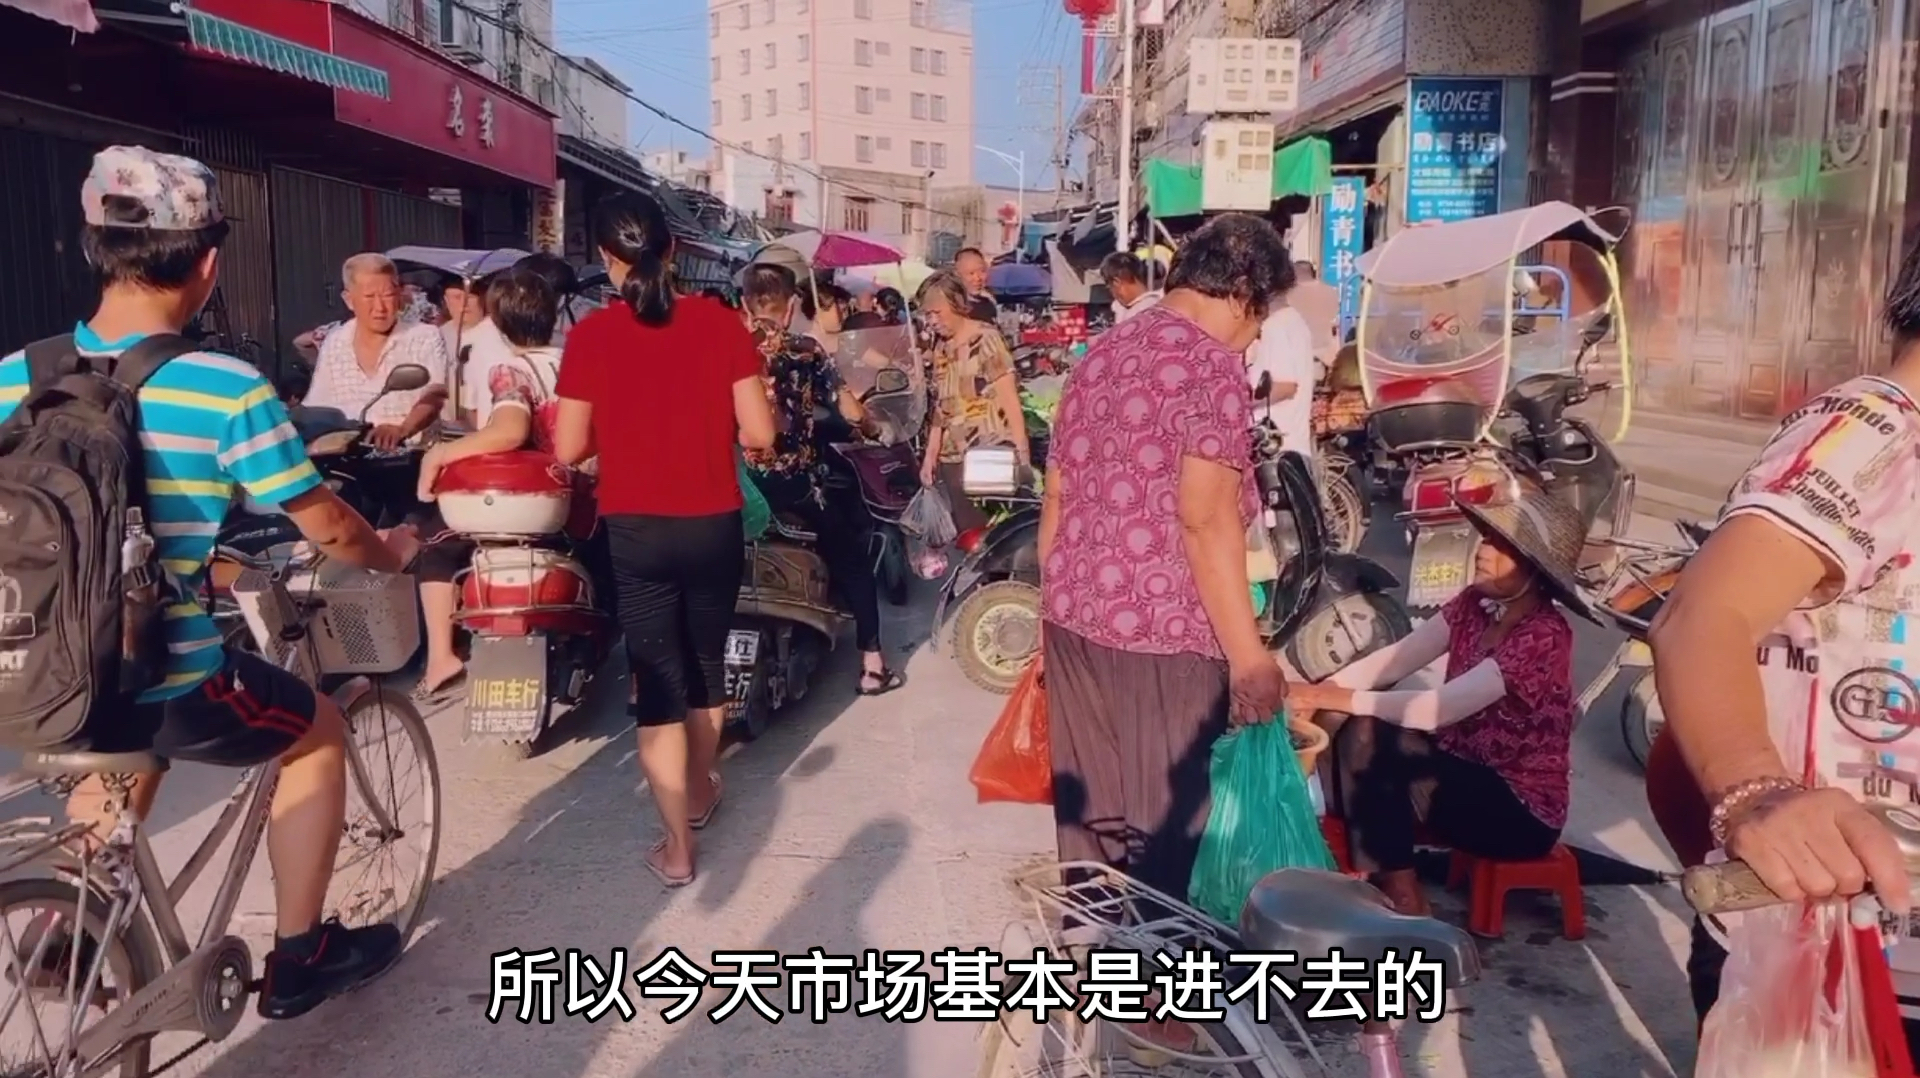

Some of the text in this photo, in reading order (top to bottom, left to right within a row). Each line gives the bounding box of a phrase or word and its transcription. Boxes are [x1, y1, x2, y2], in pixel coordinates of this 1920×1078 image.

[1415, 91, 1480, 112] BAOKE
[471, 678, 540, 709] 川田车行
[1863, 770, 1892, 798] du
